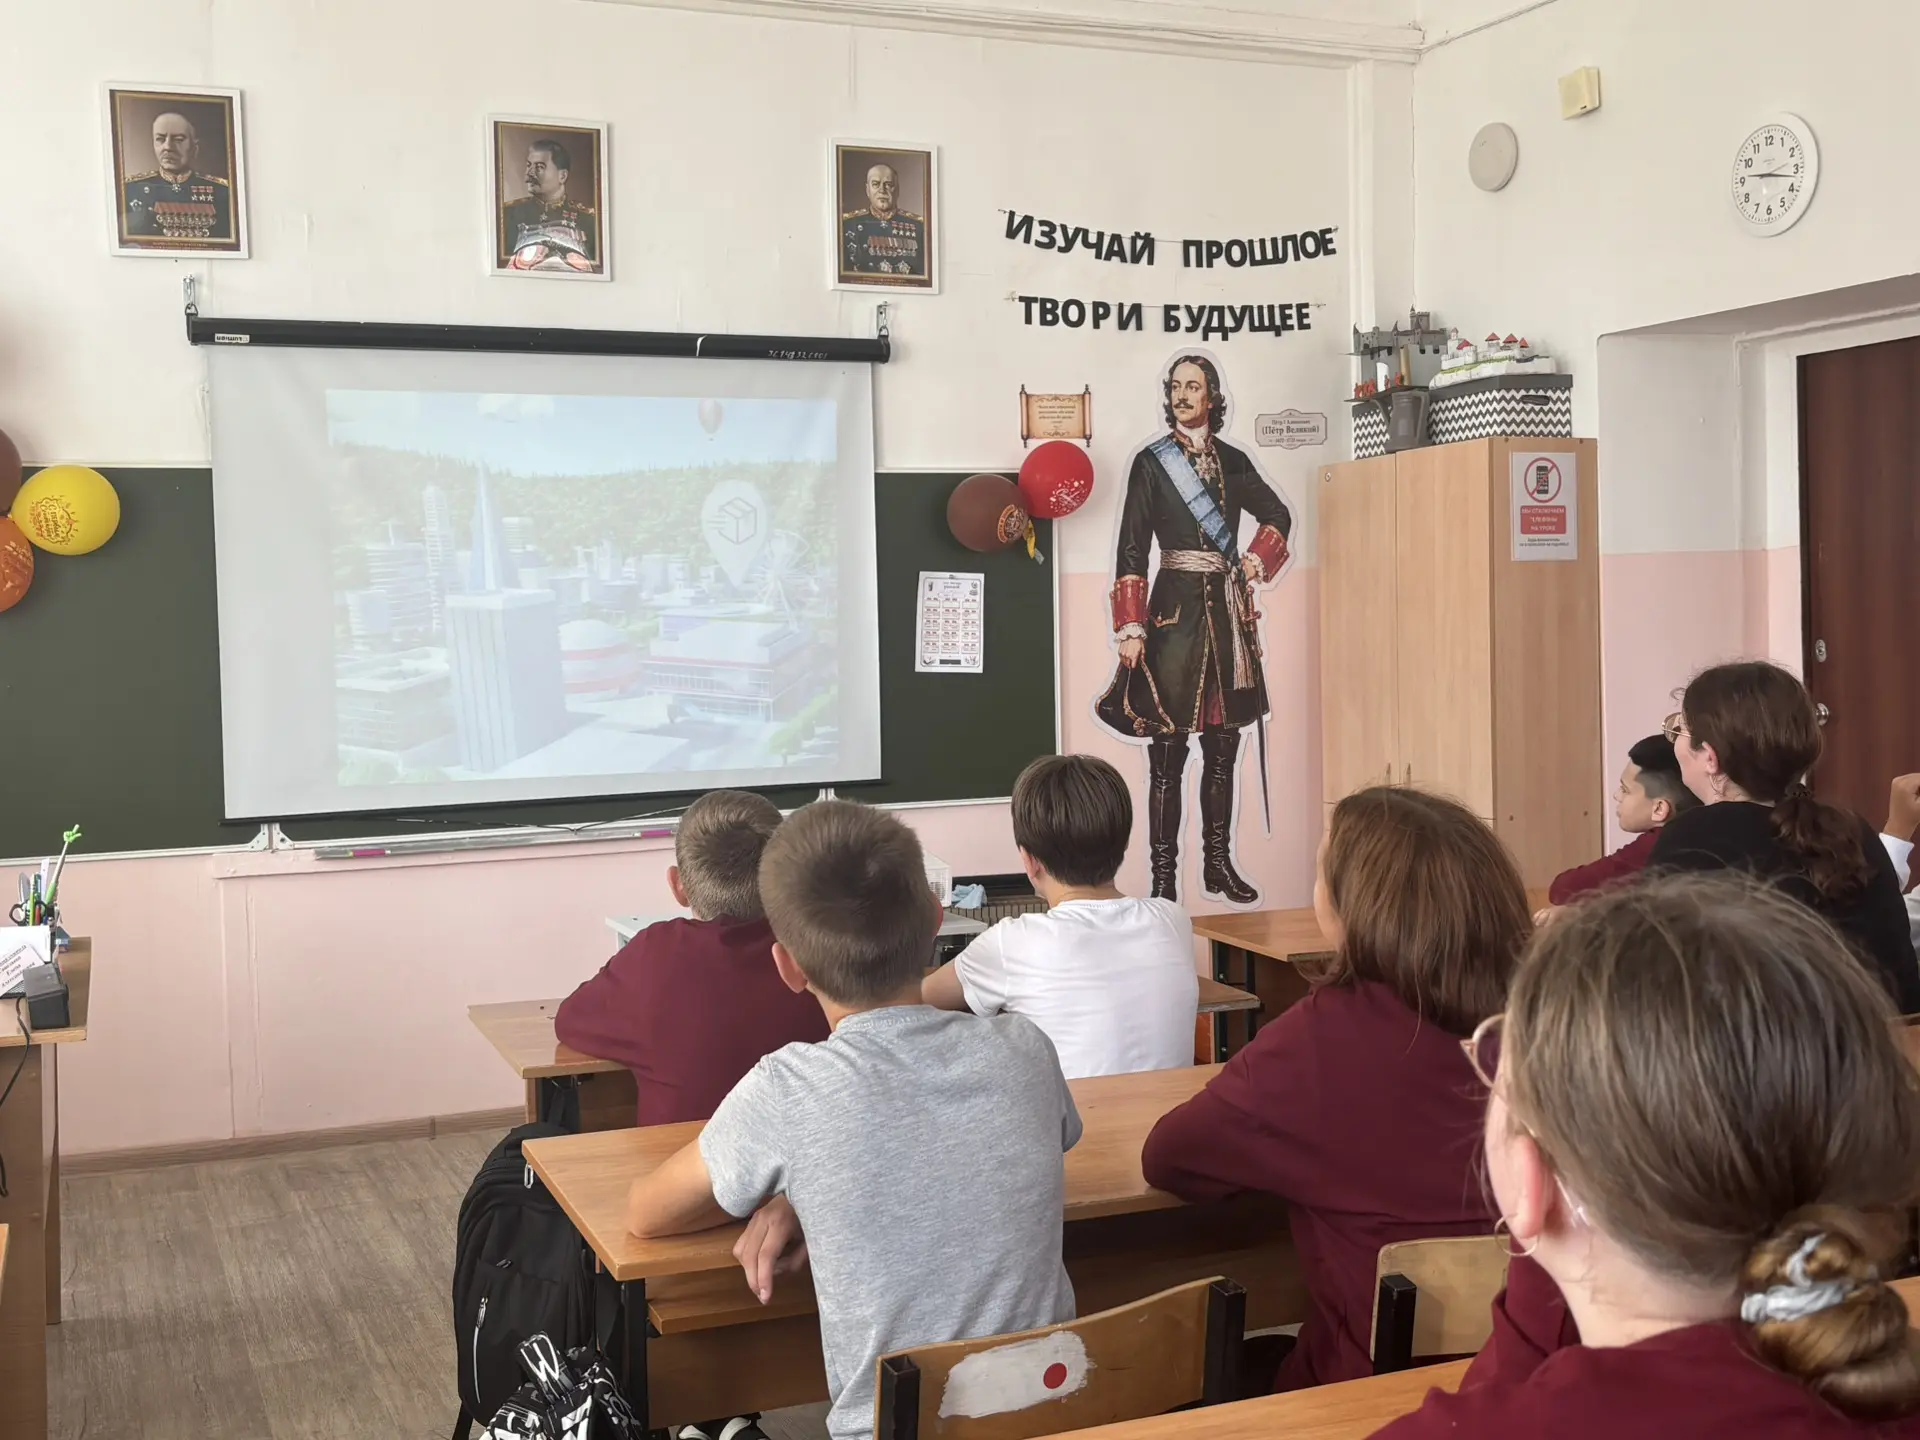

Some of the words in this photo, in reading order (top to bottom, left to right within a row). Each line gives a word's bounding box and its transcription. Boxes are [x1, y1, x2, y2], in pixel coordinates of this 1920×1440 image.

[1765, 135, 1774, 146] 12
[1780, 137, 1784, 147] 1
[1753, 143, 1760, 154] 11
[1789, 147, 1795, 158] 2
[1744, 158, 1753, 169] 10
[1793, 163, 1799, 174] 3
[1739, 176, 1746, 187] 9
[1788, 182, 1795, 193] 4
[1744, 193, 1750, 203] 8
[1780, 197, 1785, 208] 5
[1754, 203, 1760, 213] 7
[1766, 205, 1772, 215] 6
[1005, 210, 1155, 265] ИЗУЧАЙ
[1183, 227, 1336, 268] ПРОШЛОЕ
[1018, 296, 1143, 331] ТВОРИ
[1163, 302, 1311, 341] БУДУЩЕЕ
